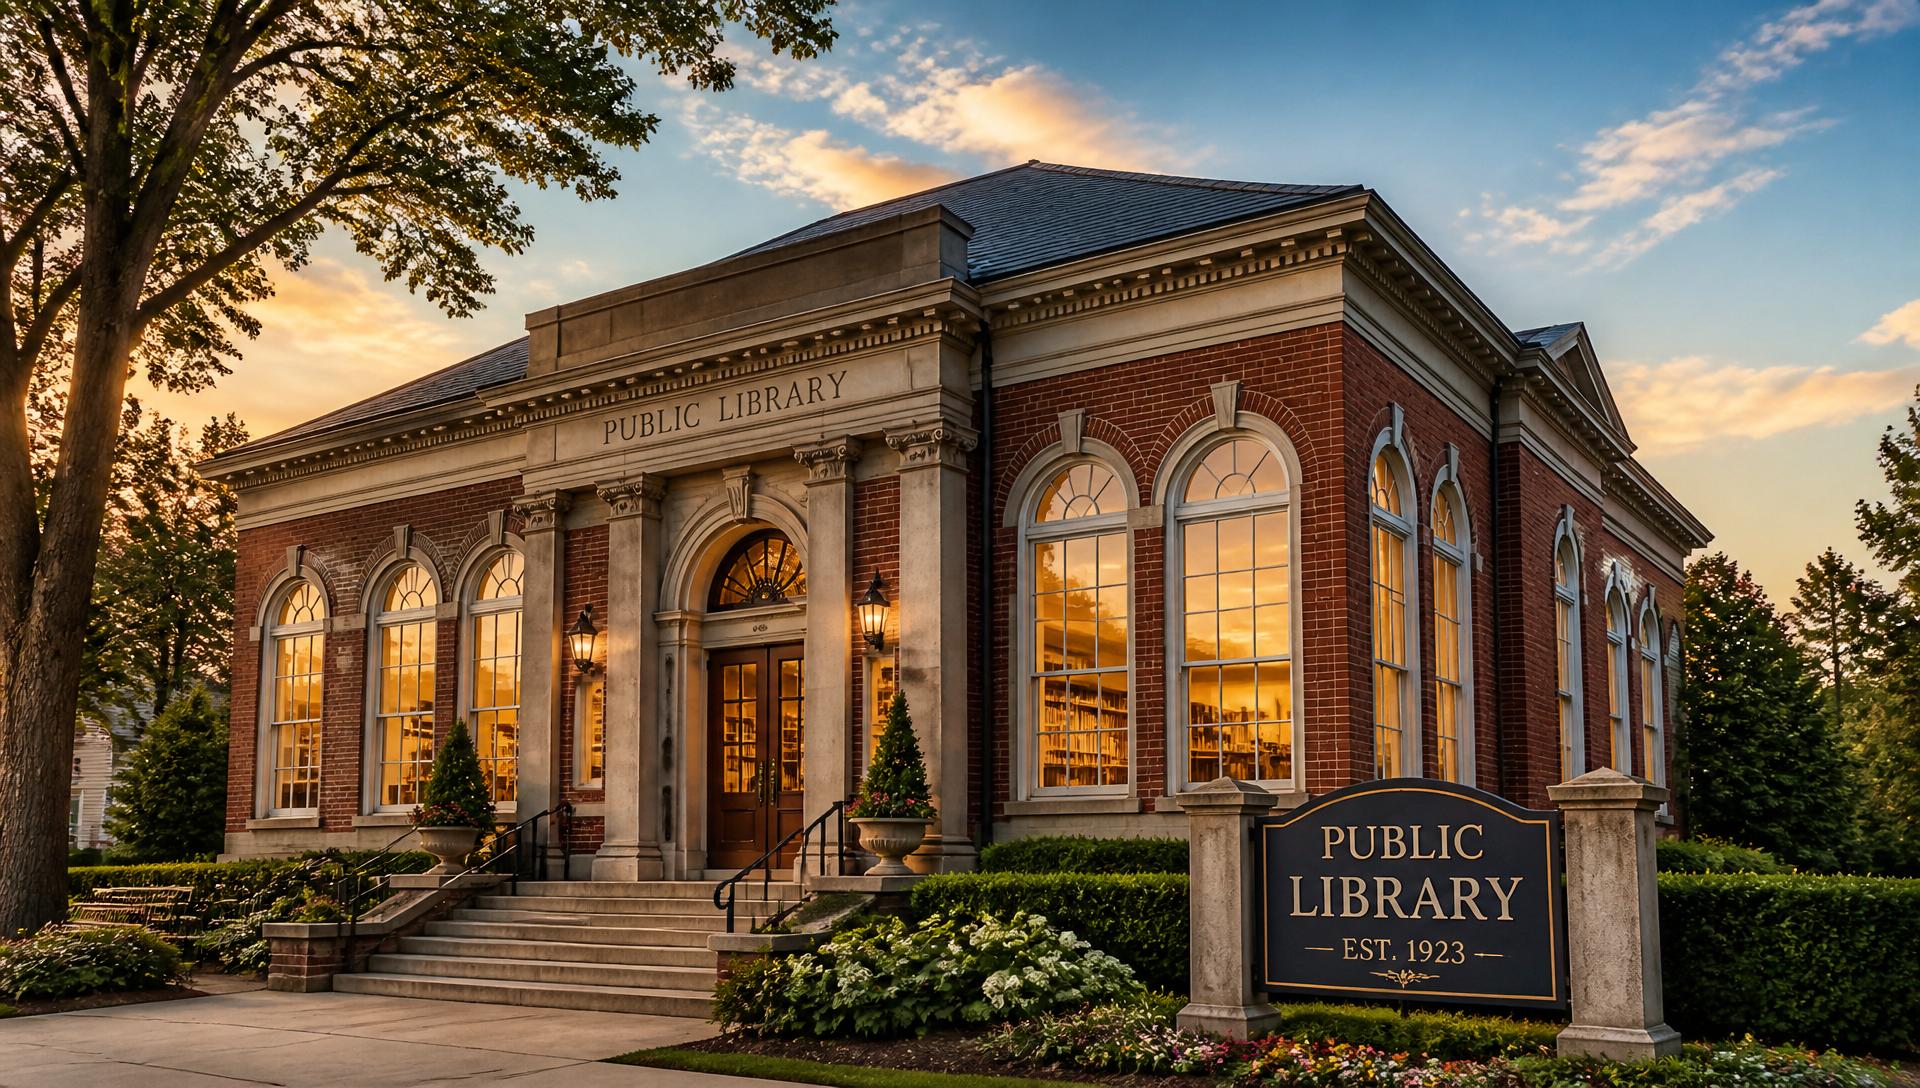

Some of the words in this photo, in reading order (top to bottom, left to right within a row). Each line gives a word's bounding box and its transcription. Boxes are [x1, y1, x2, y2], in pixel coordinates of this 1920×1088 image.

[603, 402, 700, 445] PUBLIC
[718, 370, 847, 422] LIBRARY
[1321, 824, 1484, 861] PUBLIC
[1289, 875, 1524, 921] LIBRARY
[1343, 938, 1397, 961] EST.
[1407, 939, 1466, 965] 1923
